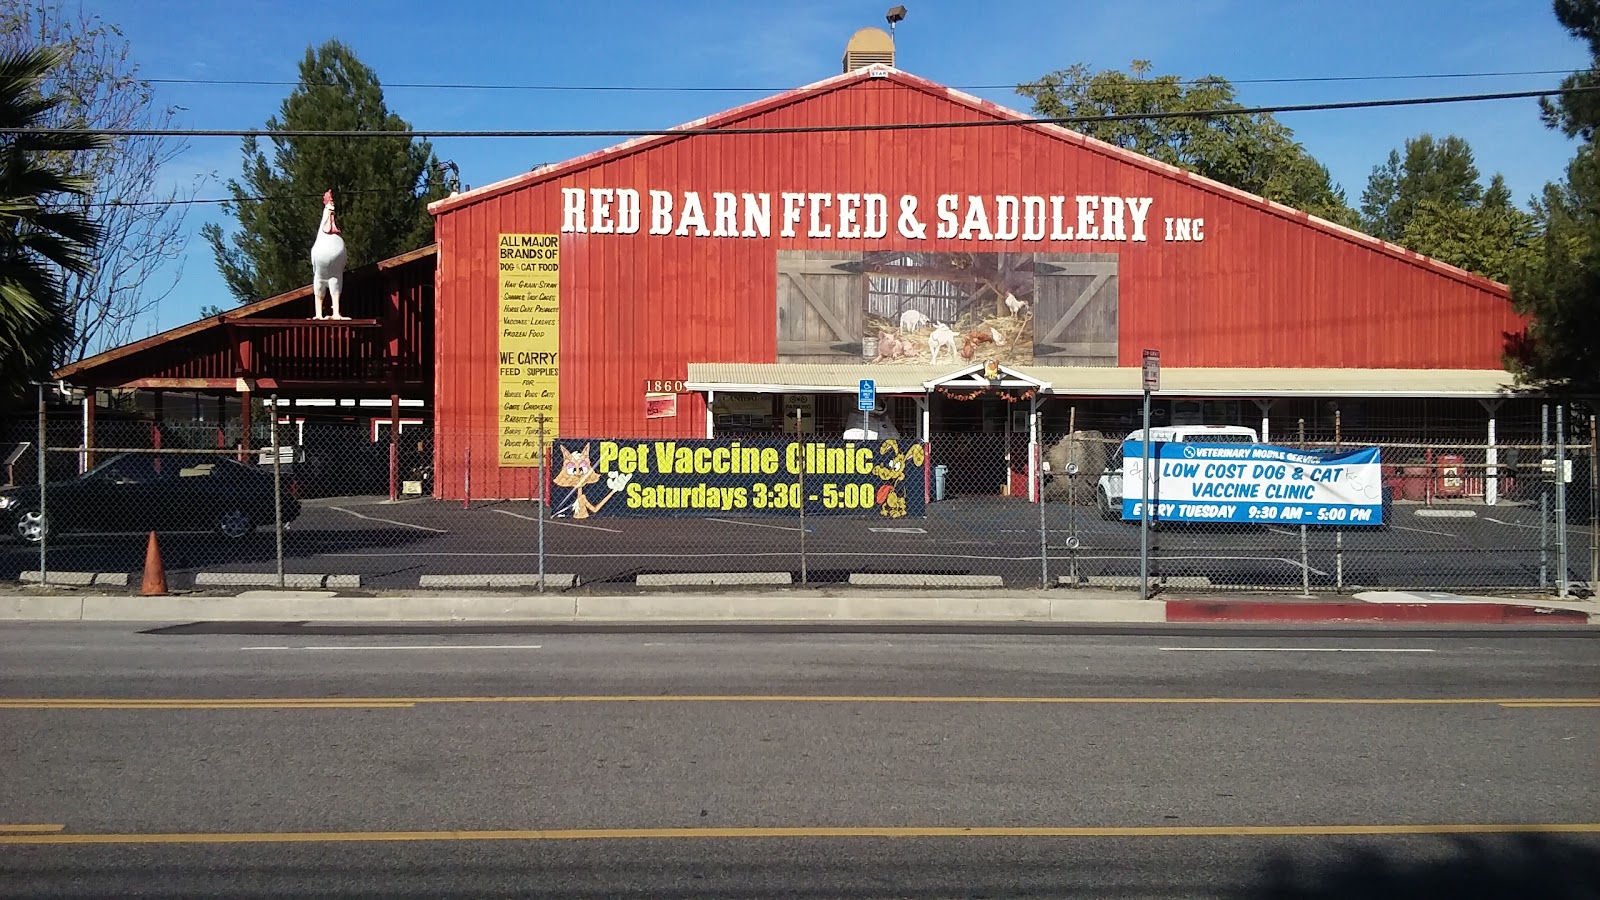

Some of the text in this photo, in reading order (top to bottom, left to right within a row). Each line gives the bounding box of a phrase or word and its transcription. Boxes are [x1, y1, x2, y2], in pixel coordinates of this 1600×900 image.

[561, 187, 641, 235] RED
[648, 189, 772, 239] BARN
[897, 193, 927, 240] &
[936, 194, 1153, 242] SADDLERY
[1164, 217, 1205, 242] INC
[500, 236, 558, 248] ALL MAJOR
[500, 248, 558, 259] BRANDS OF
[500, 263, 515, 271] DOG
[521, 263, 536, 271] CAT
[538, 263, 559, 271] FOOD
[530, 316, 556, 325] LEASHES
[503, 328, 545, 338] FROZEN FOOD
[500, 351, 557, 365] WE CARRY
[500, 367, 559, 376] FEED SUPPLIES
[647, 380, 683, 392] 1860
[599, 441, 874, 475] Pet Vaccine Clinic
[1196, 447, 1250, 458] VETERINARY
[1252, 449, 1285, 459] MOBILE
[1162, 462, 1200, 479] LOW
[1204, 463, 1247, 479] COST
[1252, 464, 1286, 480] DOG
[1291, 466, 1304, 480] &
[1309, 467, 1343, 483] CAT
[626, 482, 748, 511] Saturdays
[752, 482, 803, 509] 3:30
[823, 482, 875, 509] 5:00
[1191, 482, 1316, 500] VACCINE CLINIC
[1178, 504, 1237, 519] TUESDAY
[1248, 505, 1278, 519] 9:30
[1279, 506, 1304, 520] AM
[1316, 507, 1346, 521] 5:00
[1349, 508, 1372, 522] PM
